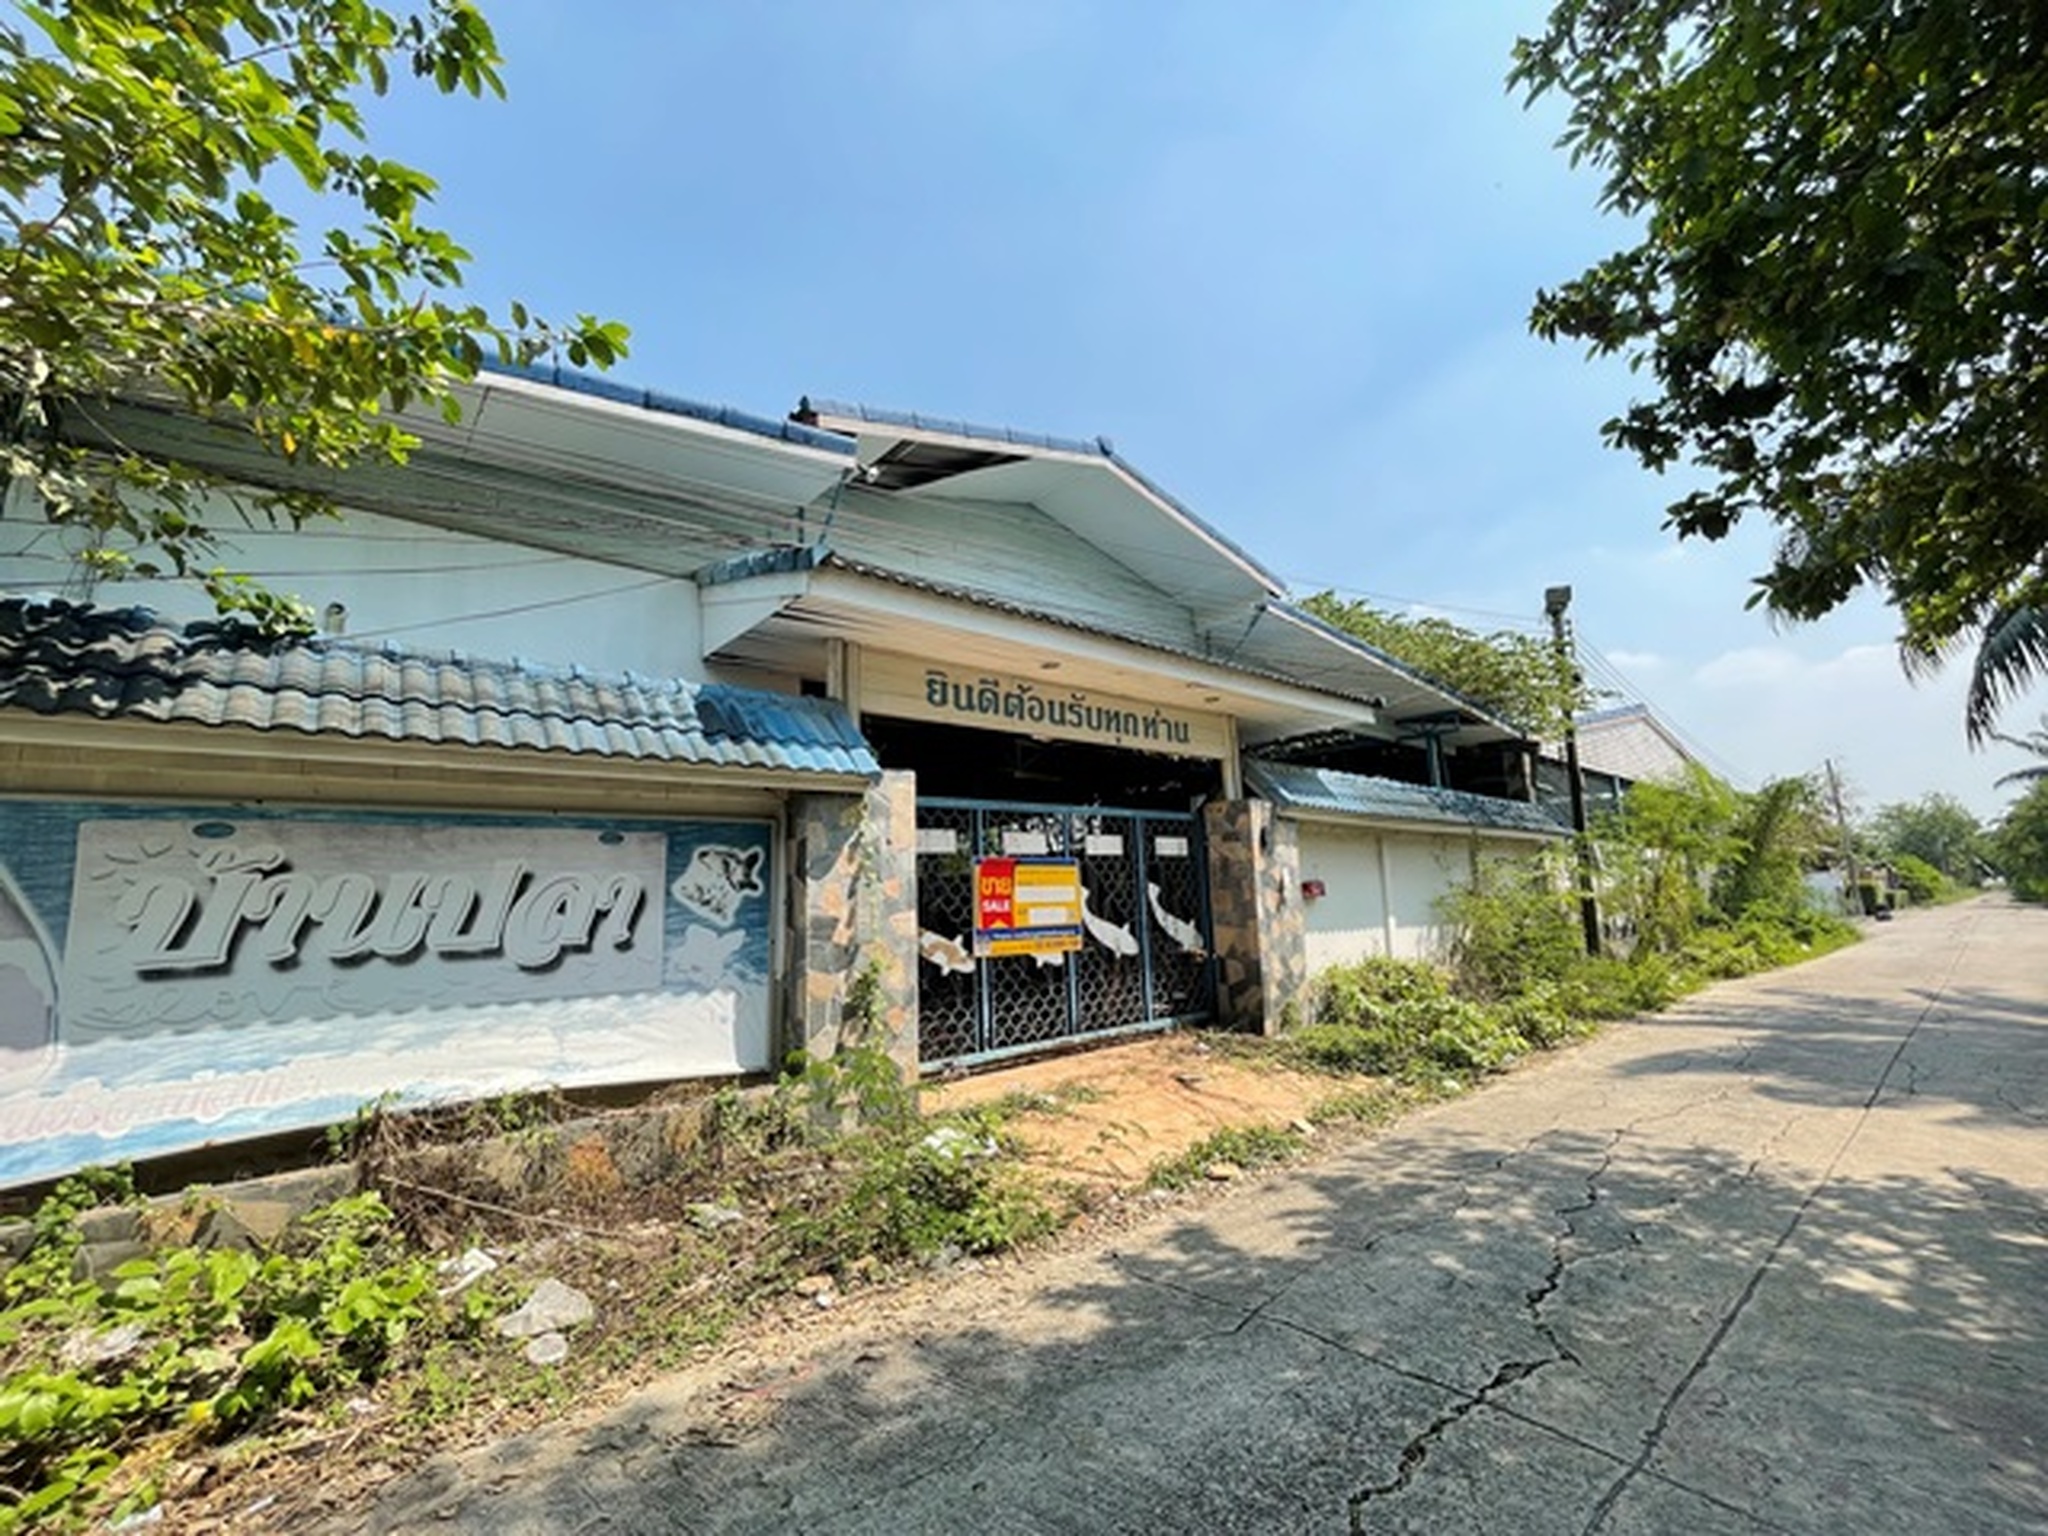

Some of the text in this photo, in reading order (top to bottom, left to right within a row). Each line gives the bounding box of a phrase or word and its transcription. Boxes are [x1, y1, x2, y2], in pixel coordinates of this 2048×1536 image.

[924, 669, 1191, 744] ยินดีต้อนรับทุกท่าน
[980, 876, 1012, 897] ขาย
[981, 898, 1012, 914] SALE
